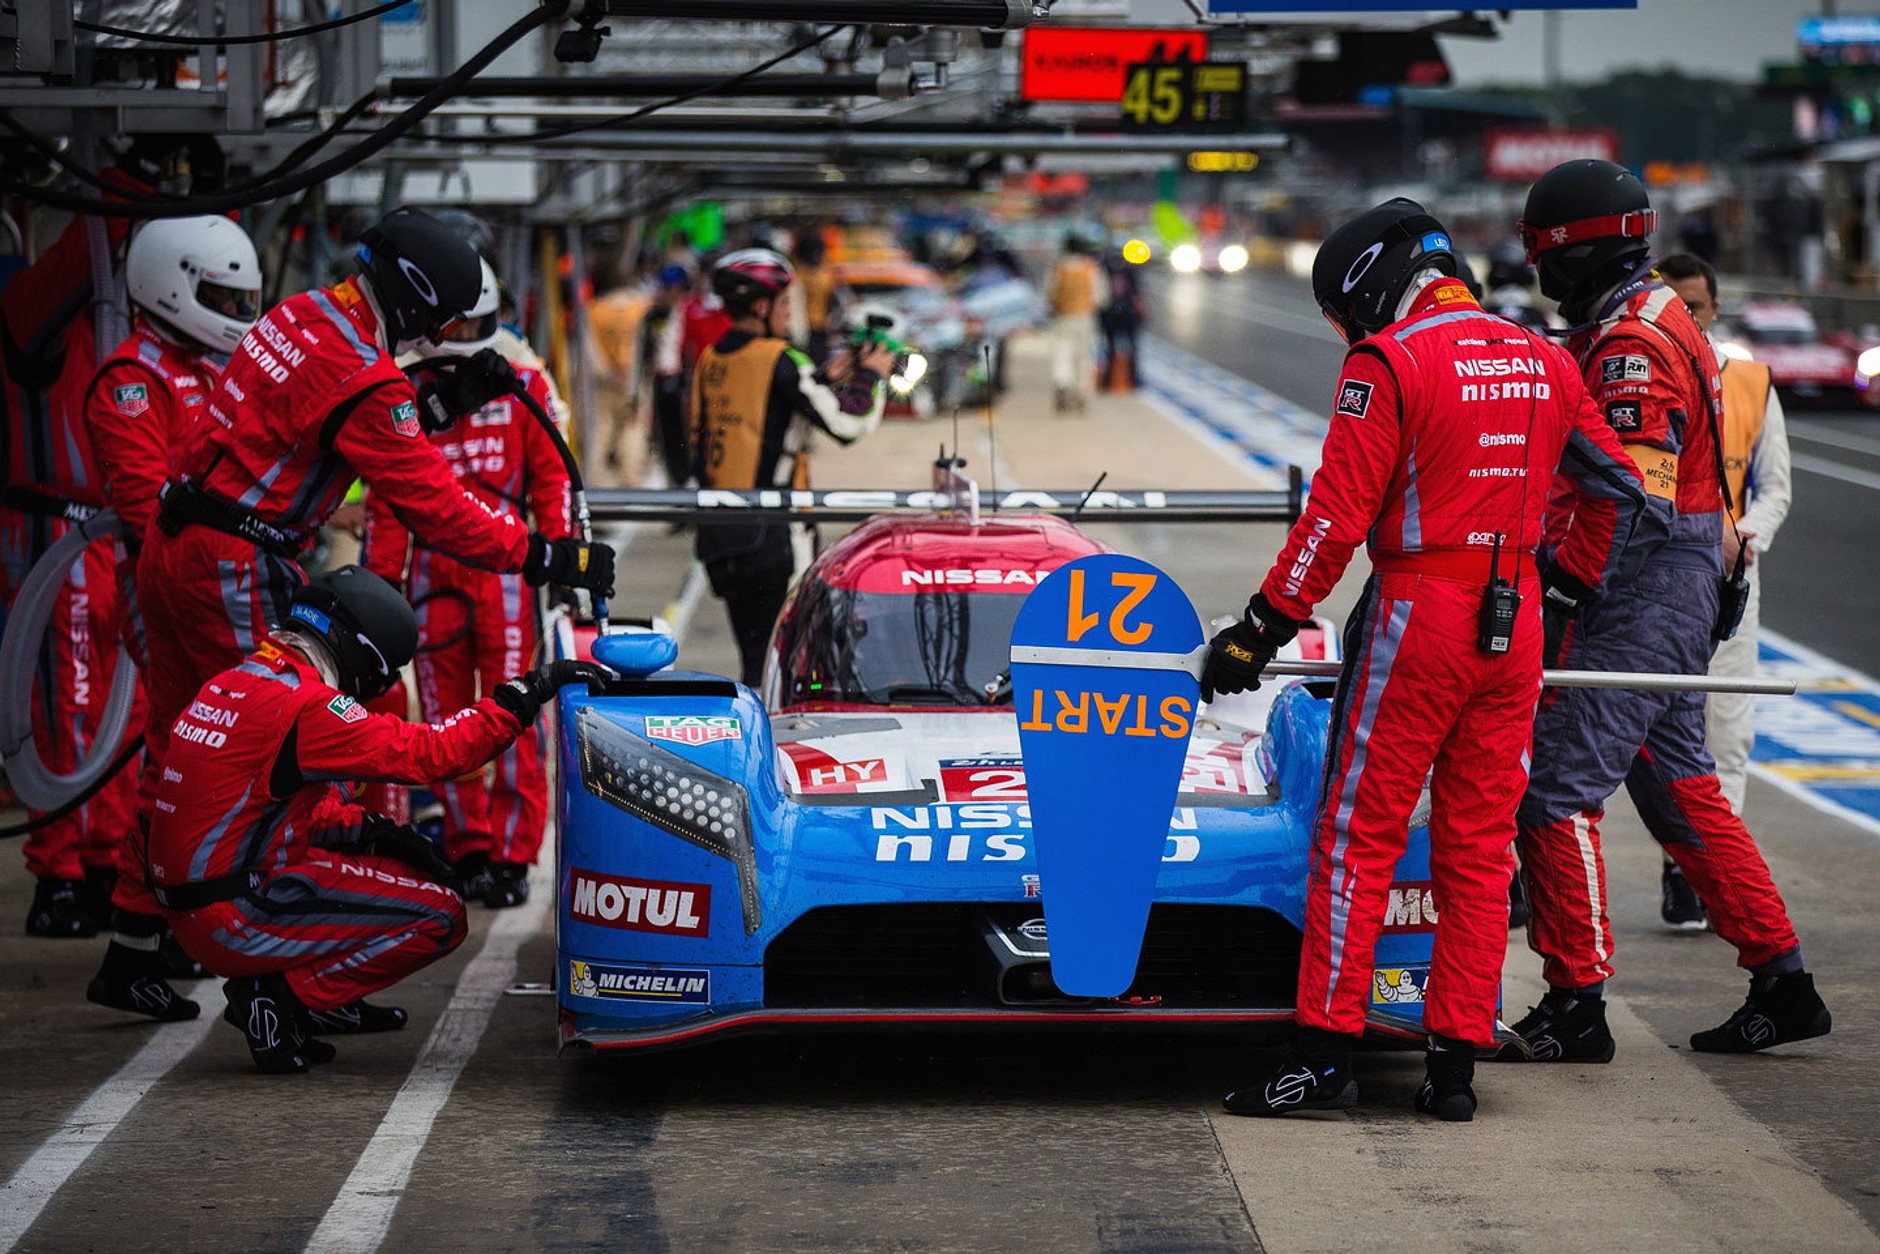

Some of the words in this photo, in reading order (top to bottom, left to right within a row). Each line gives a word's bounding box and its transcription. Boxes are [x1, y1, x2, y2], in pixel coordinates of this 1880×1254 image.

[1122, 67, 1183, 124] 45
[256, 315, 306, 368] NISSAN
[242, 333, 289, 384] nismo
[1453, 358, 1546, 377] NISSAN
[1462, 382, 1551, 402] nismo
[1478, 432, 1527, 447] @nismo
[1281, 517, 1331, 596] NISSAN
[1066, 569, 1158, 646] 21
[649, 716, 736, 729] TAG
[1020, 688, 1192, 739] START
[648, 727, 739, 744] HEUER
[810, 759, 882, 788] HY
[969, 769, 1028, 797] 2
[573, 877, 700, 929] MOTUL
[599, 972, 706, 993] MICHELIN
